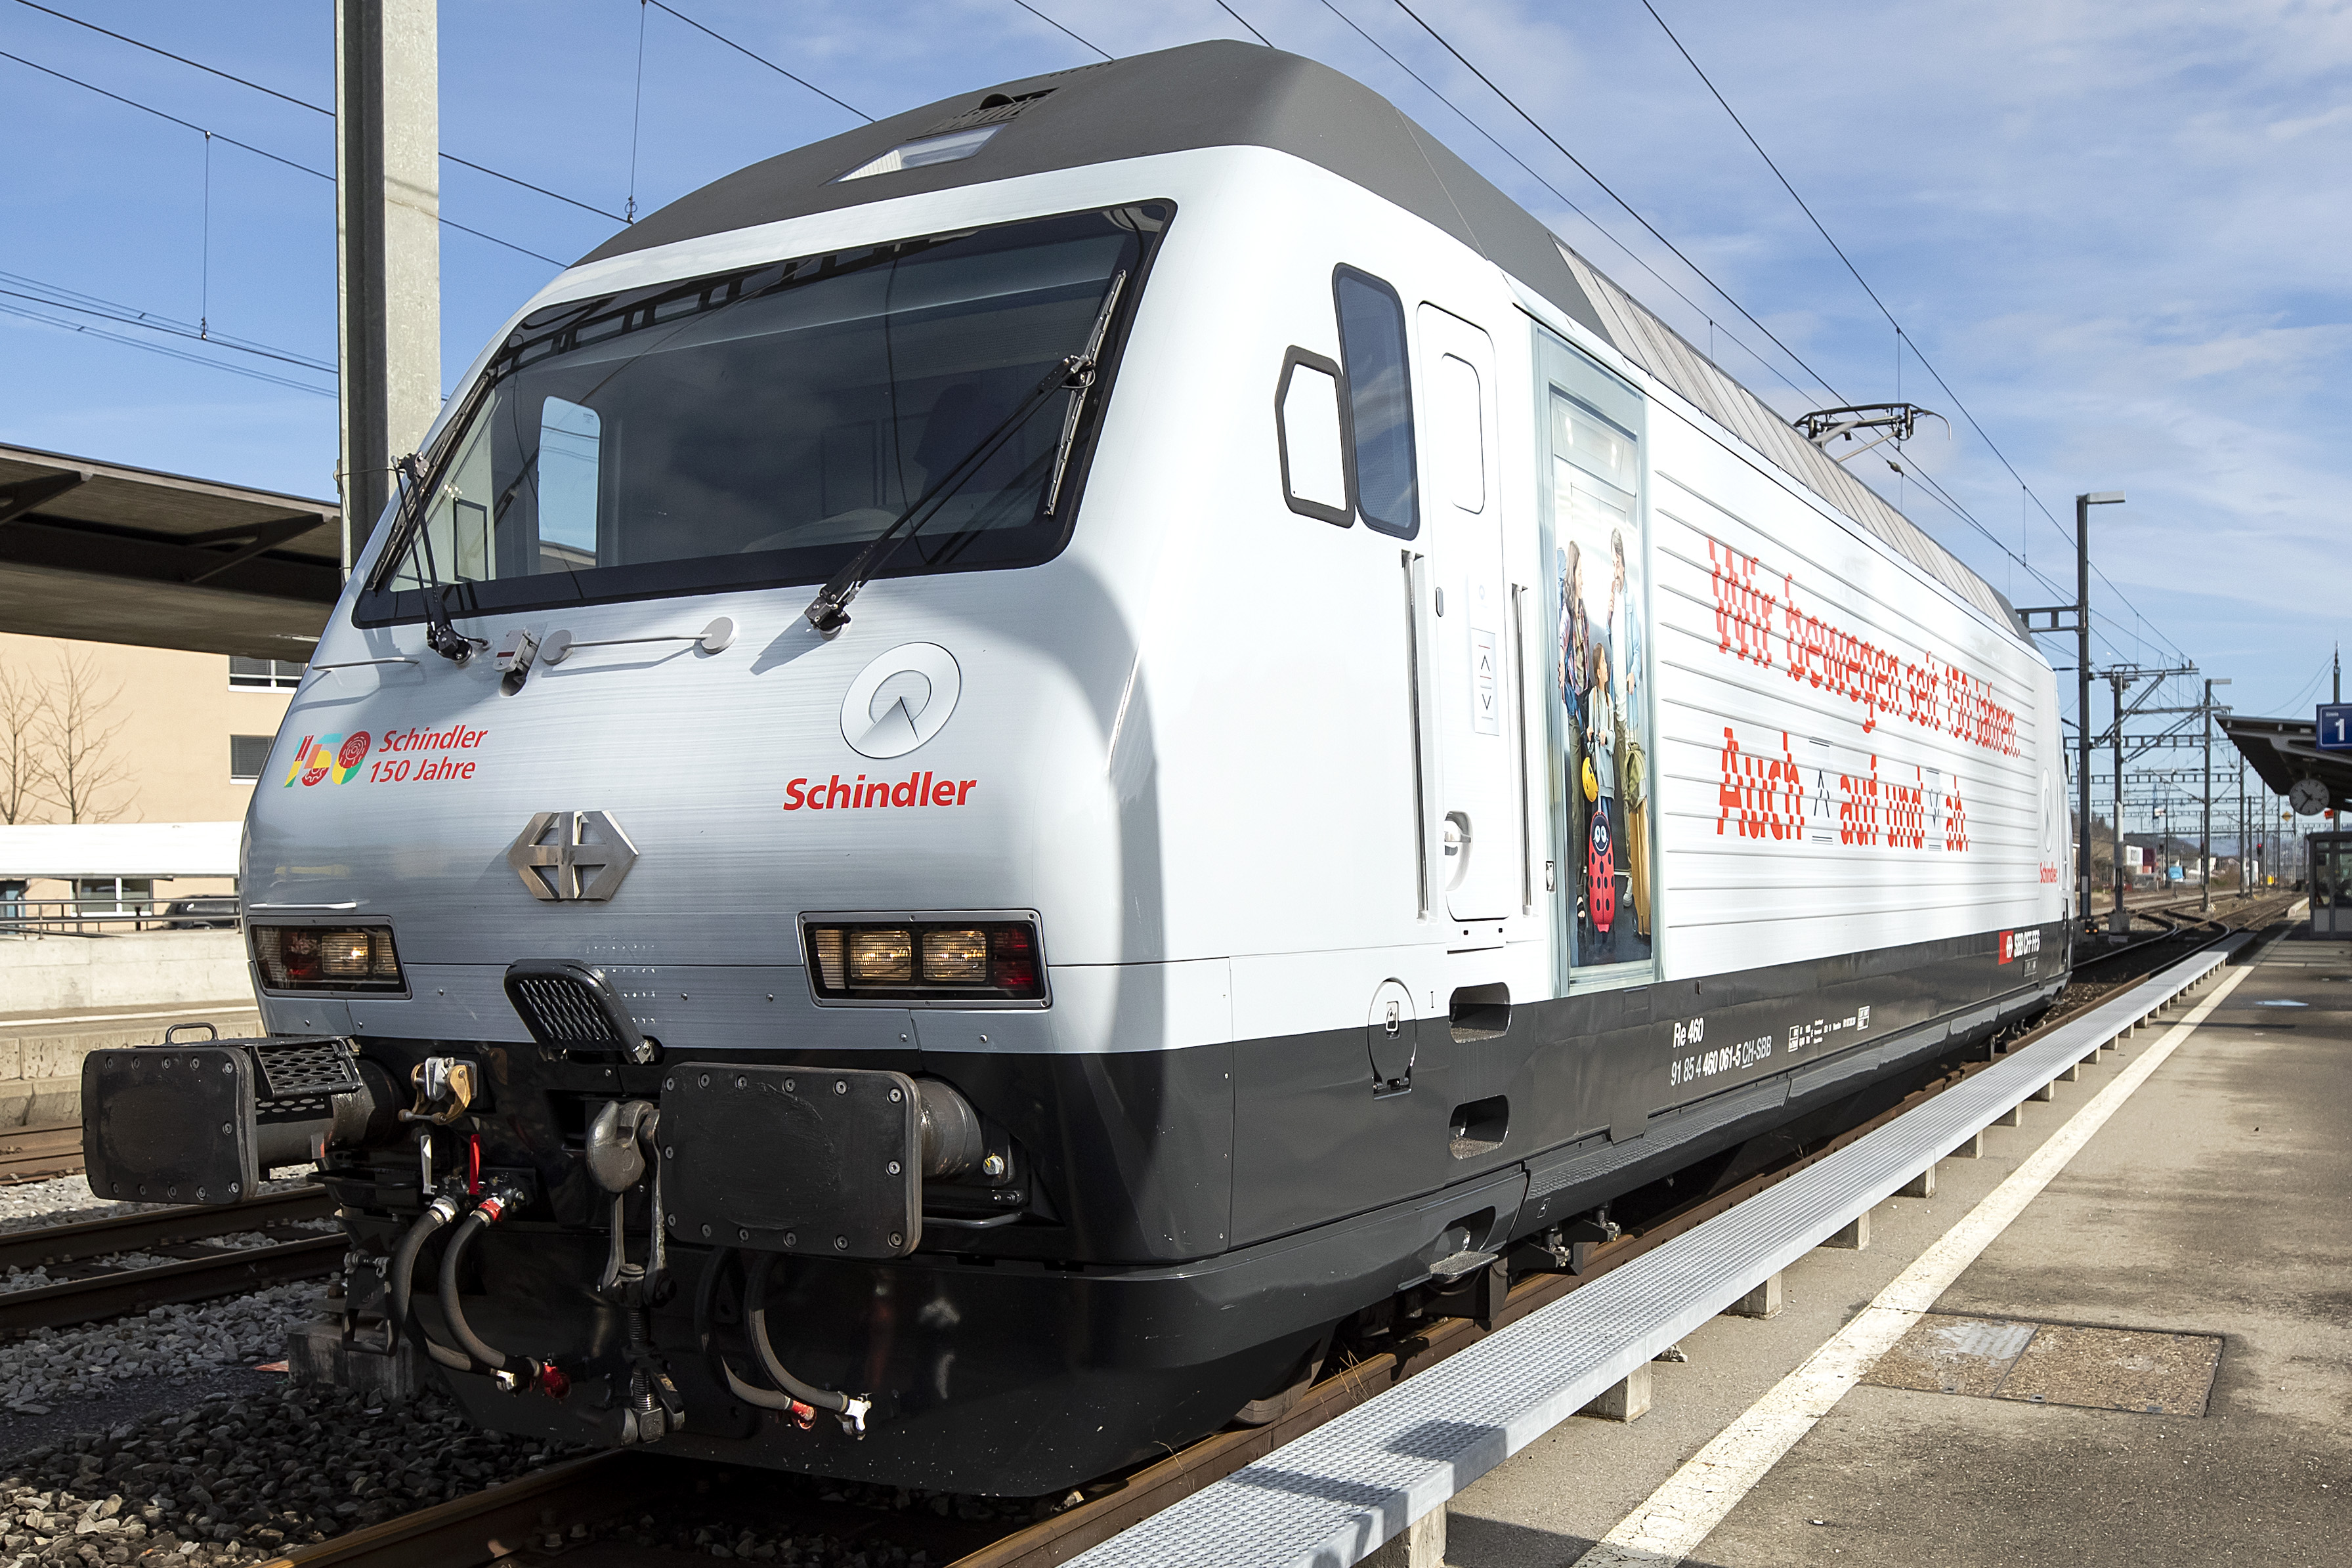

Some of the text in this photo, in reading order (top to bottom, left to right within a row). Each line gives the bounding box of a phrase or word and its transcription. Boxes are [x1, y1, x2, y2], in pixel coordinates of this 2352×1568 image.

[1709, 540, 1776, 669] Wir
[1783, 574, 1902, 733] bewegen
[1906, 652, 1941, 731] seit
[1944, 665, 1973, 742] 150
[378, 725, 488, 753] Schindler
[2335, 718, 2345, 742] 1
[371, 755, 476, 783] 150 Jahre
[783, 771, 977, 811] Schindler
[1717, 727, 1805, 841] Auch
[1839, 753, 1879, 847] auf
[1885, 766, 1925, 850] und
[2040, 861, 2058, 883] Schindler
[2014, 933, 2023, 958] SBB
[2032, 929, 2040, 952] FFS
[1673, 1017, 1704, 1048] Re 460
[1671, 1060, 1682, 1086] 91
[1683, 1056, 1695, 1082] 85
[1696, 1055, 1702, 1078] 4
[1702, 1050, 1718, 1076] 460
[1719, 1043, 1742, 1072] 061-5
[1742, 1035, 1772, 1069] CH-SBB
